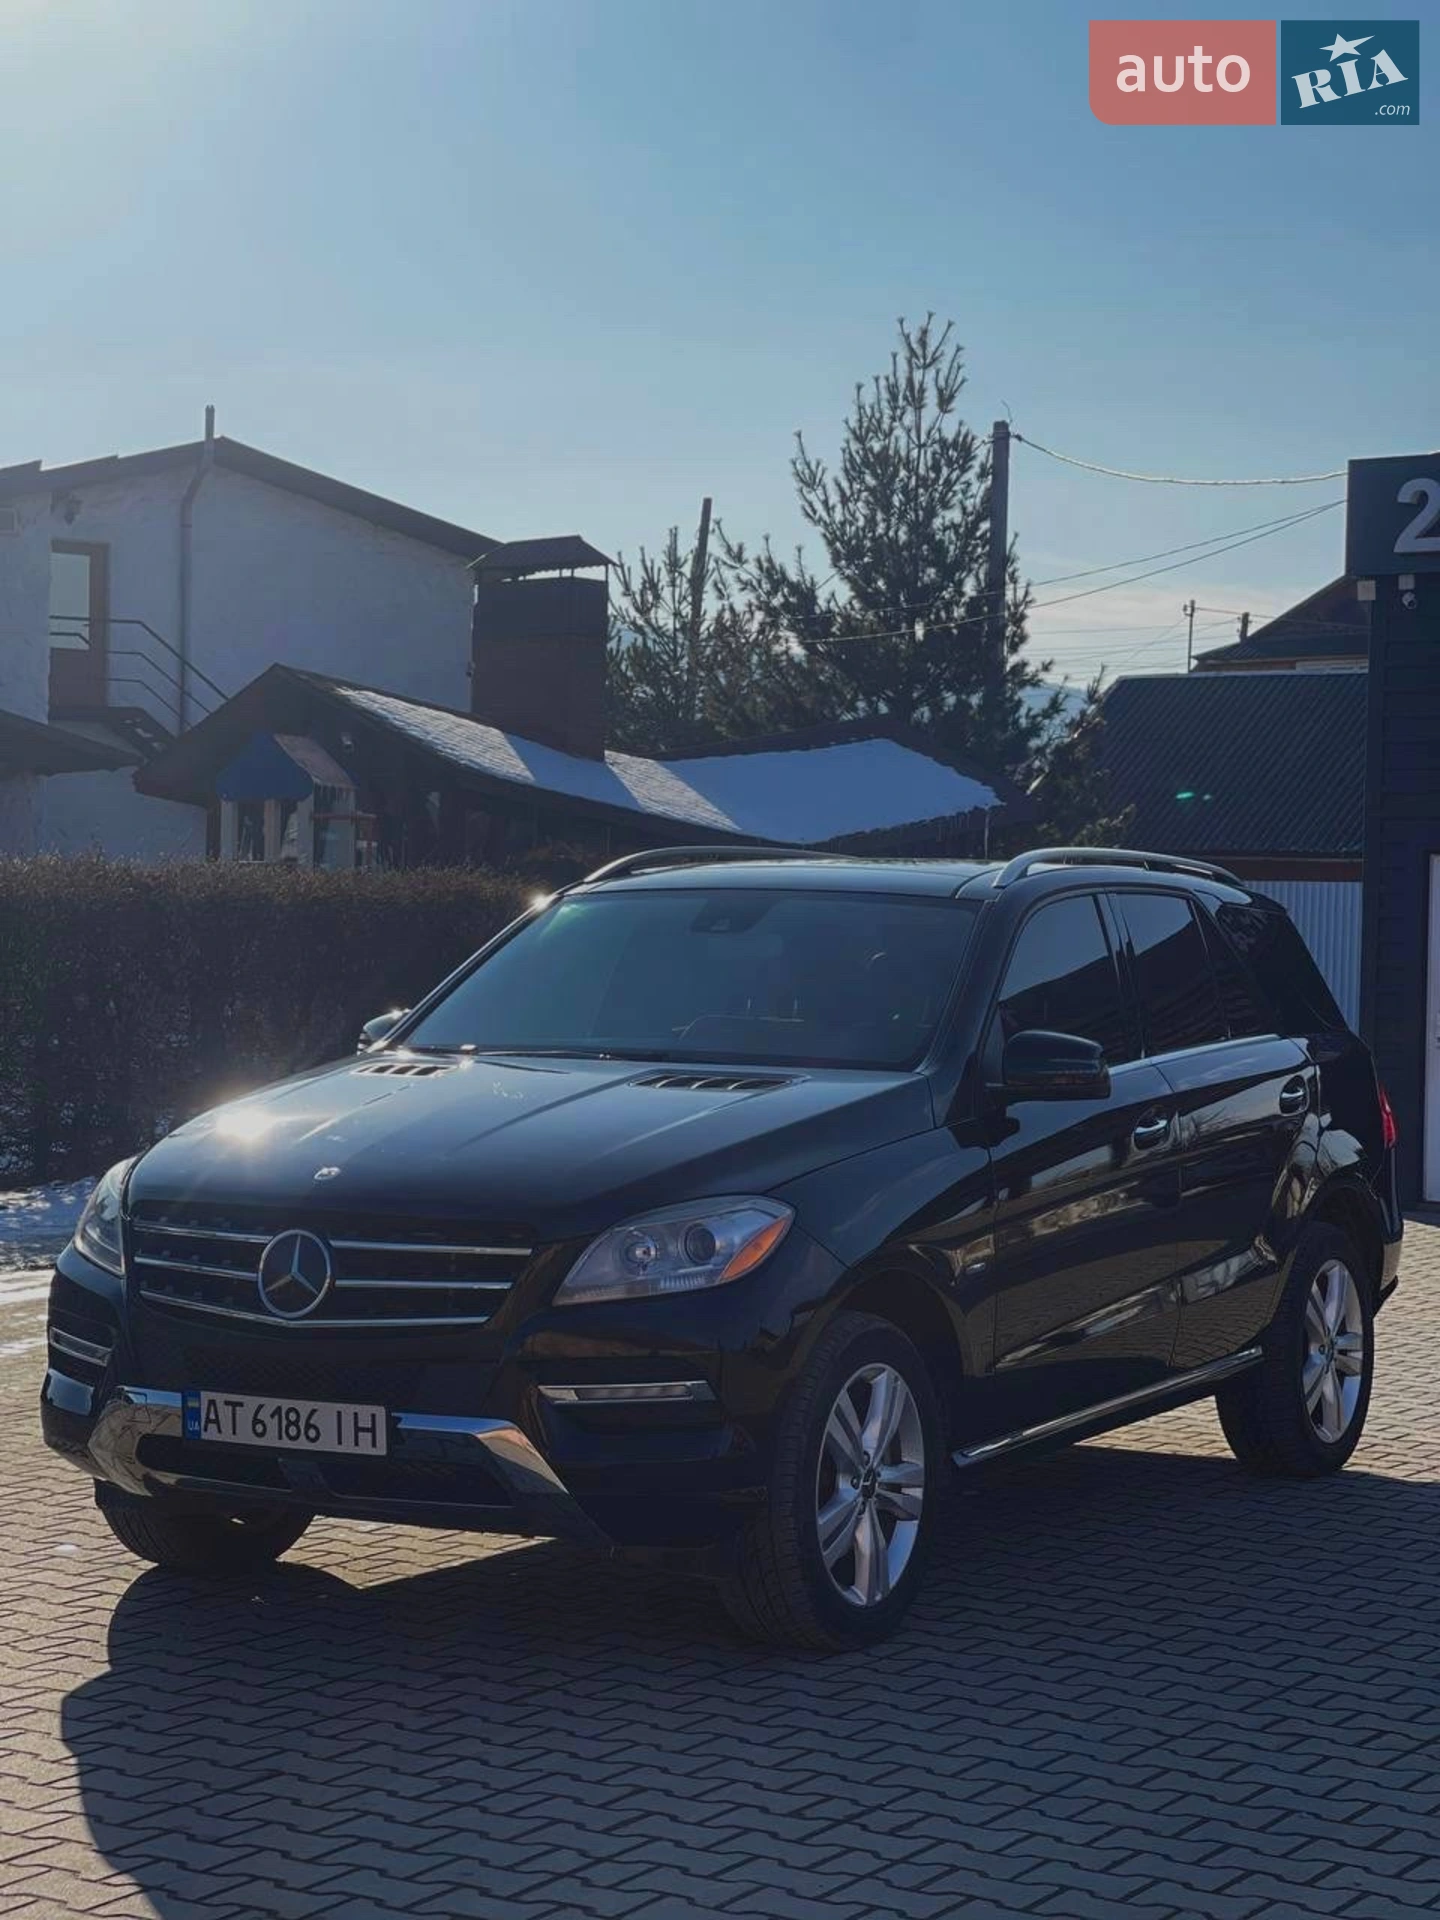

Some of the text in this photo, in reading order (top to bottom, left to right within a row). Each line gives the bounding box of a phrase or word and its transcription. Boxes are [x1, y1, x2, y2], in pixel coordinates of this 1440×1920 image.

[203, 1399, 377, 1448] AT 6186 IH
